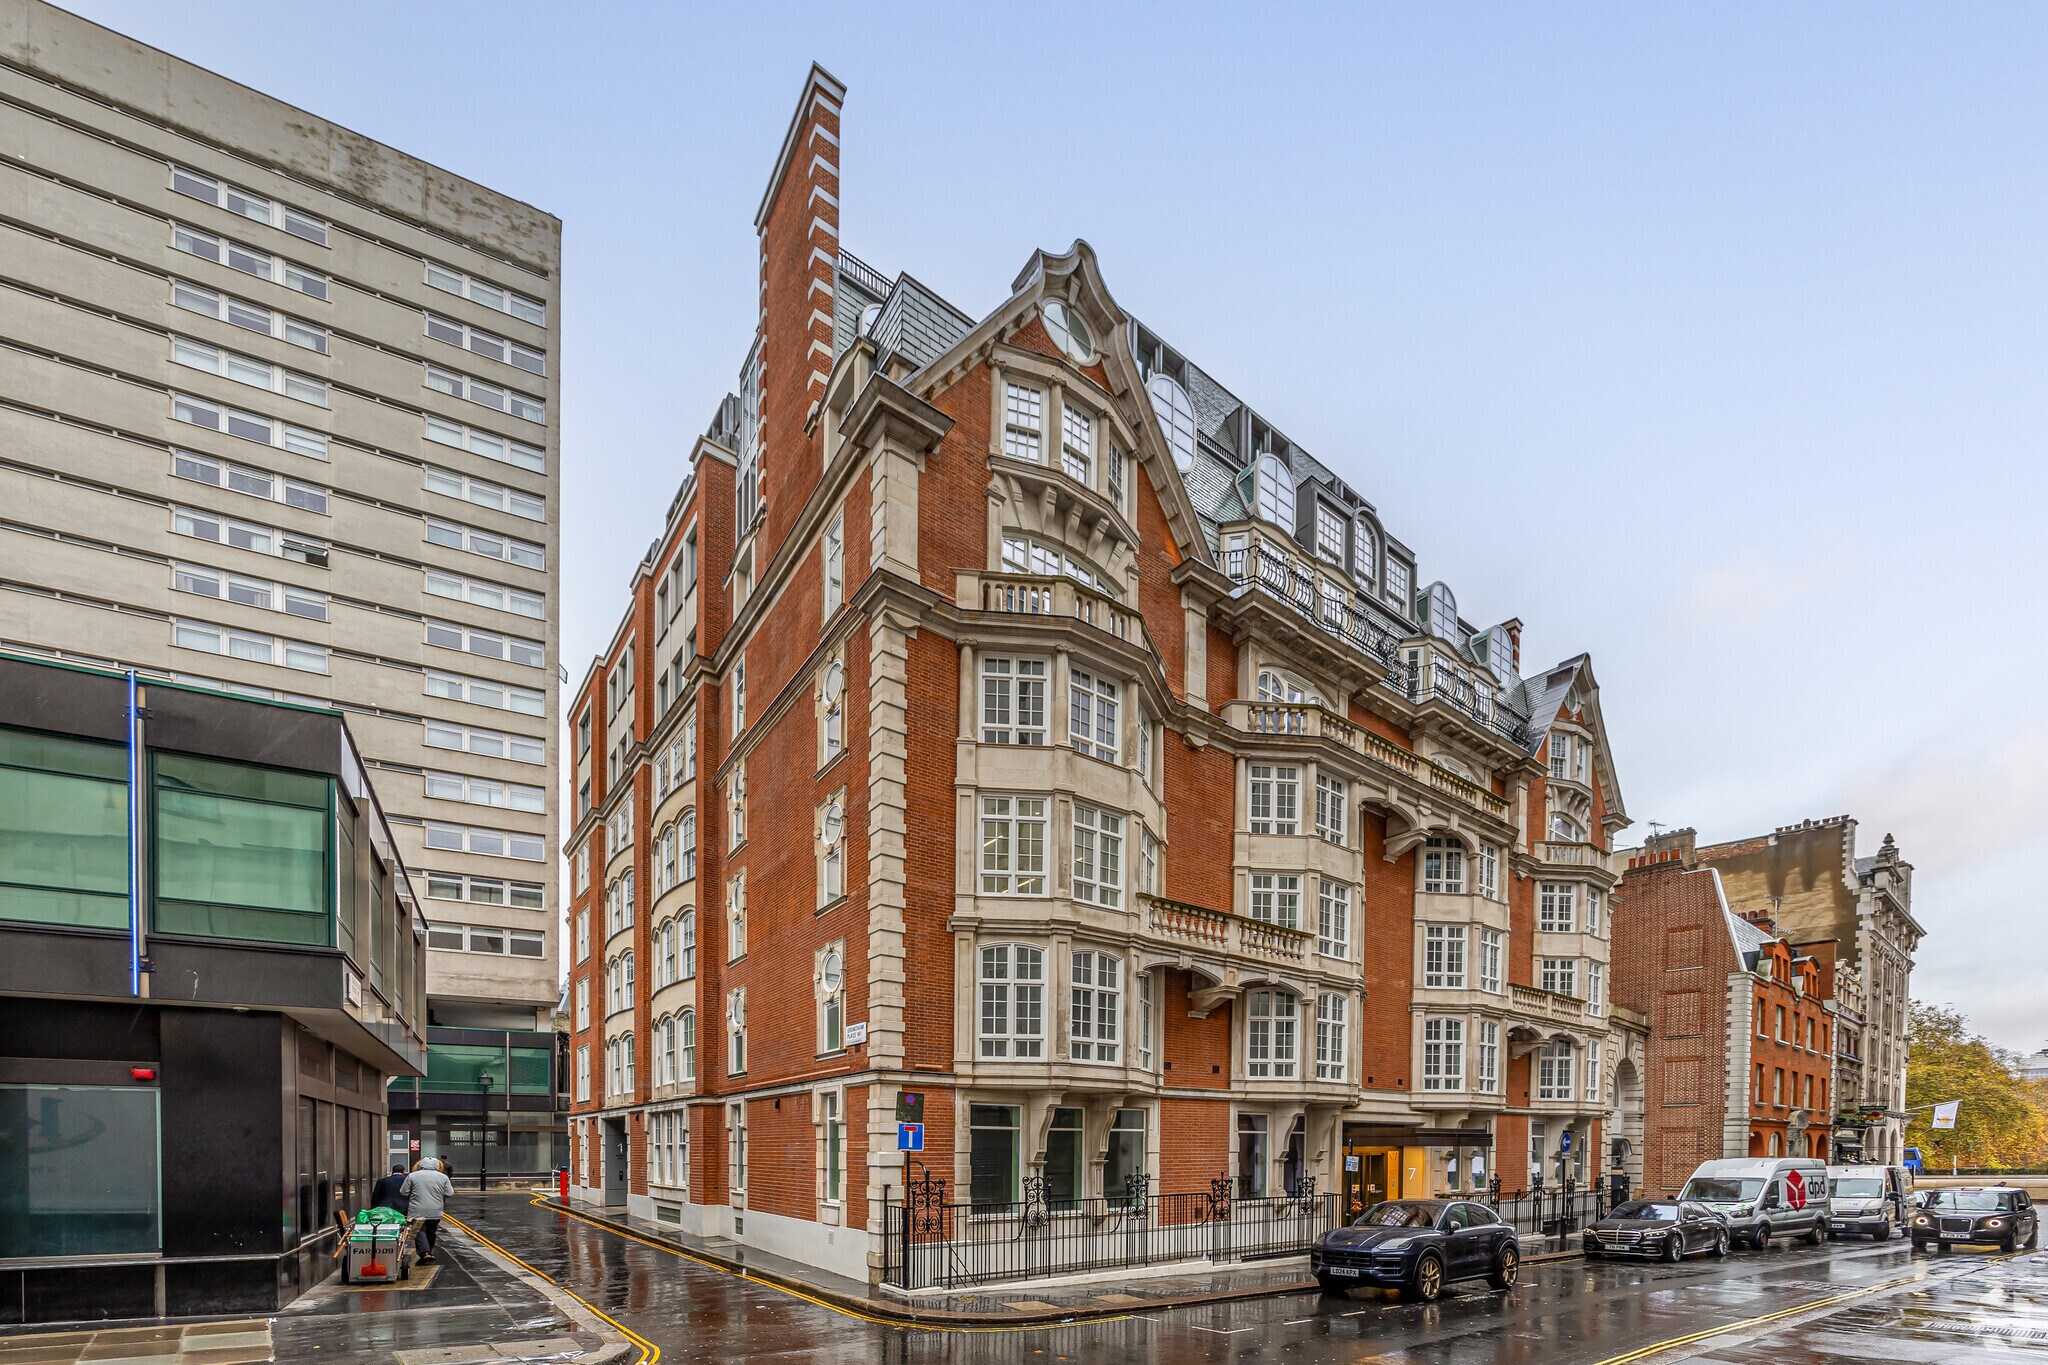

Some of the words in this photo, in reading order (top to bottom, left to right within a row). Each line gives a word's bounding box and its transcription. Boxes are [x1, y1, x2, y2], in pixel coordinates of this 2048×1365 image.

[618, 1142, 623, 1154] 1
[1408, 1168, 1416, 1180] 7
[1808, 1176, 1826, 1199] dpd
